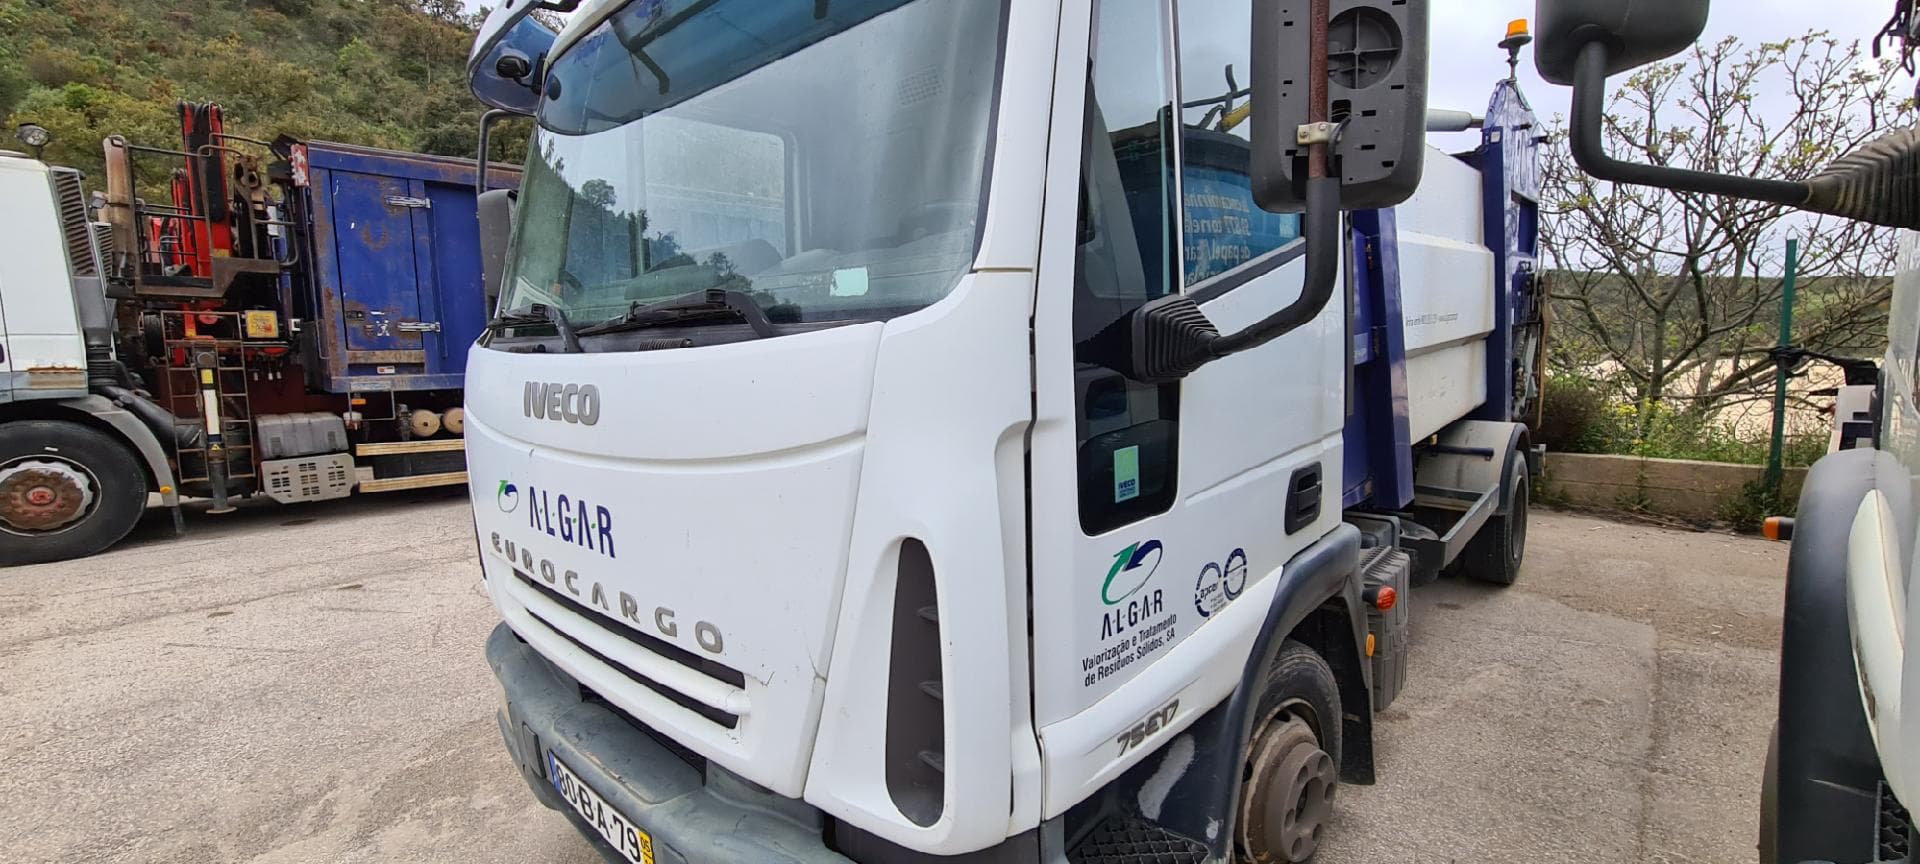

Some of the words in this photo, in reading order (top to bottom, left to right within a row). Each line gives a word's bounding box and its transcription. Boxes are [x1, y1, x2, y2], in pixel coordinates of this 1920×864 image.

[524, 381, 600, 426] IVECO
[491, 532, 724, 654] EUROCARGO
[1082, 639, 1130, 672] Valorização
[1131, 636, 1137, 647] e
[1139, 614, 1177, 642] Tratamento
[1084, 673, 1096, 687] de
[1166, 627, 1175, 642] SA
[1117, 698, 1180, 758] 75E17
